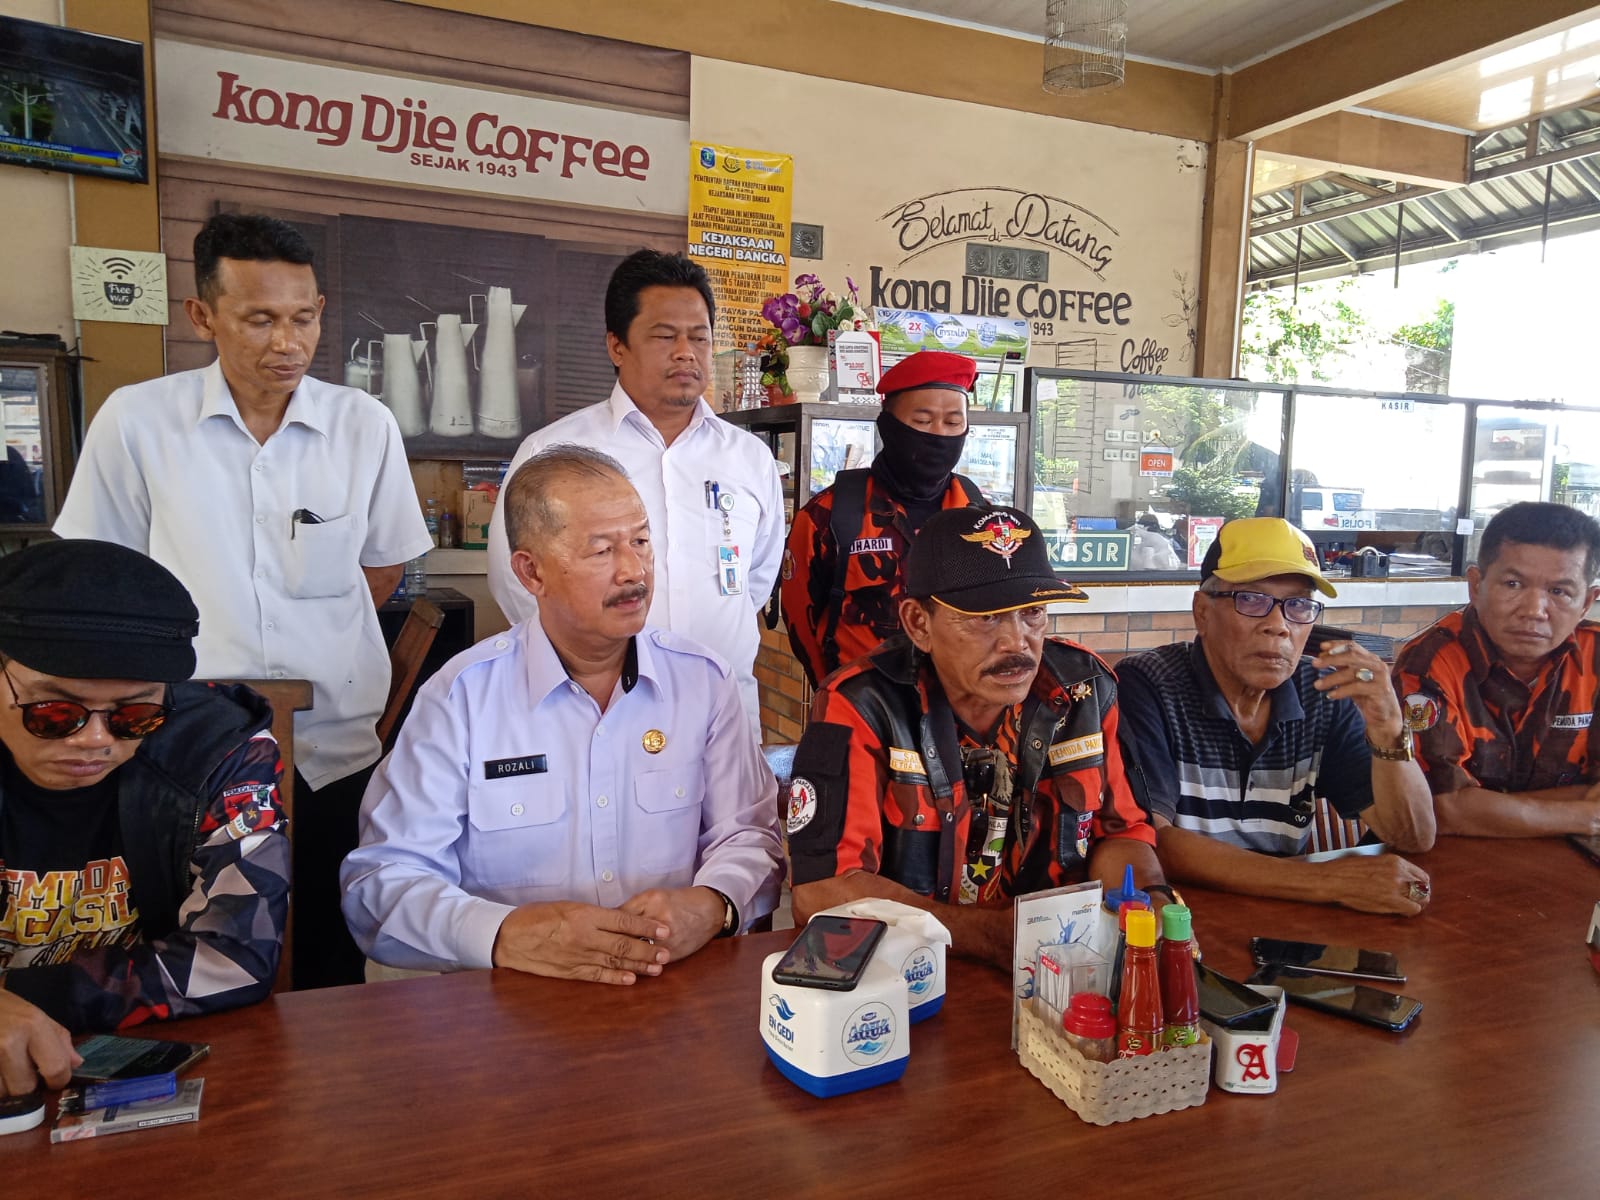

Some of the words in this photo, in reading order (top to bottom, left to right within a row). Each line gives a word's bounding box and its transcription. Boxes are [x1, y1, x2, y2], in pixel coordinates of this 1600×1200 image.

[360, 94, 457, 153] Djie
[410, 152, 470, 173] SEJAK
[475, 160, 518, 178] 1943
[892, 200, 992, 251] Selamat
[1006, 193, 1113, 272] Datang
[988, 228, 1002, 242] di
[702, 232, 773, 250] KEJAKSAAN
[689, 244, 733, 259] NEGERI
[736, 249, 785, 265] BANGKA
[108, 283, 132, 294] Free
[908, 322, 922, 331] 2X
[738, 333, 762, 342] SETAR
[1120, 337, 1169, 374] Coffee
[1381, 401, 1410, 411] KASIR
[1147, 459, 1166, 468] OPEN
[497, 761, 535, 774] ROZALI
[777, 1022, 794, 1044] GEDI
